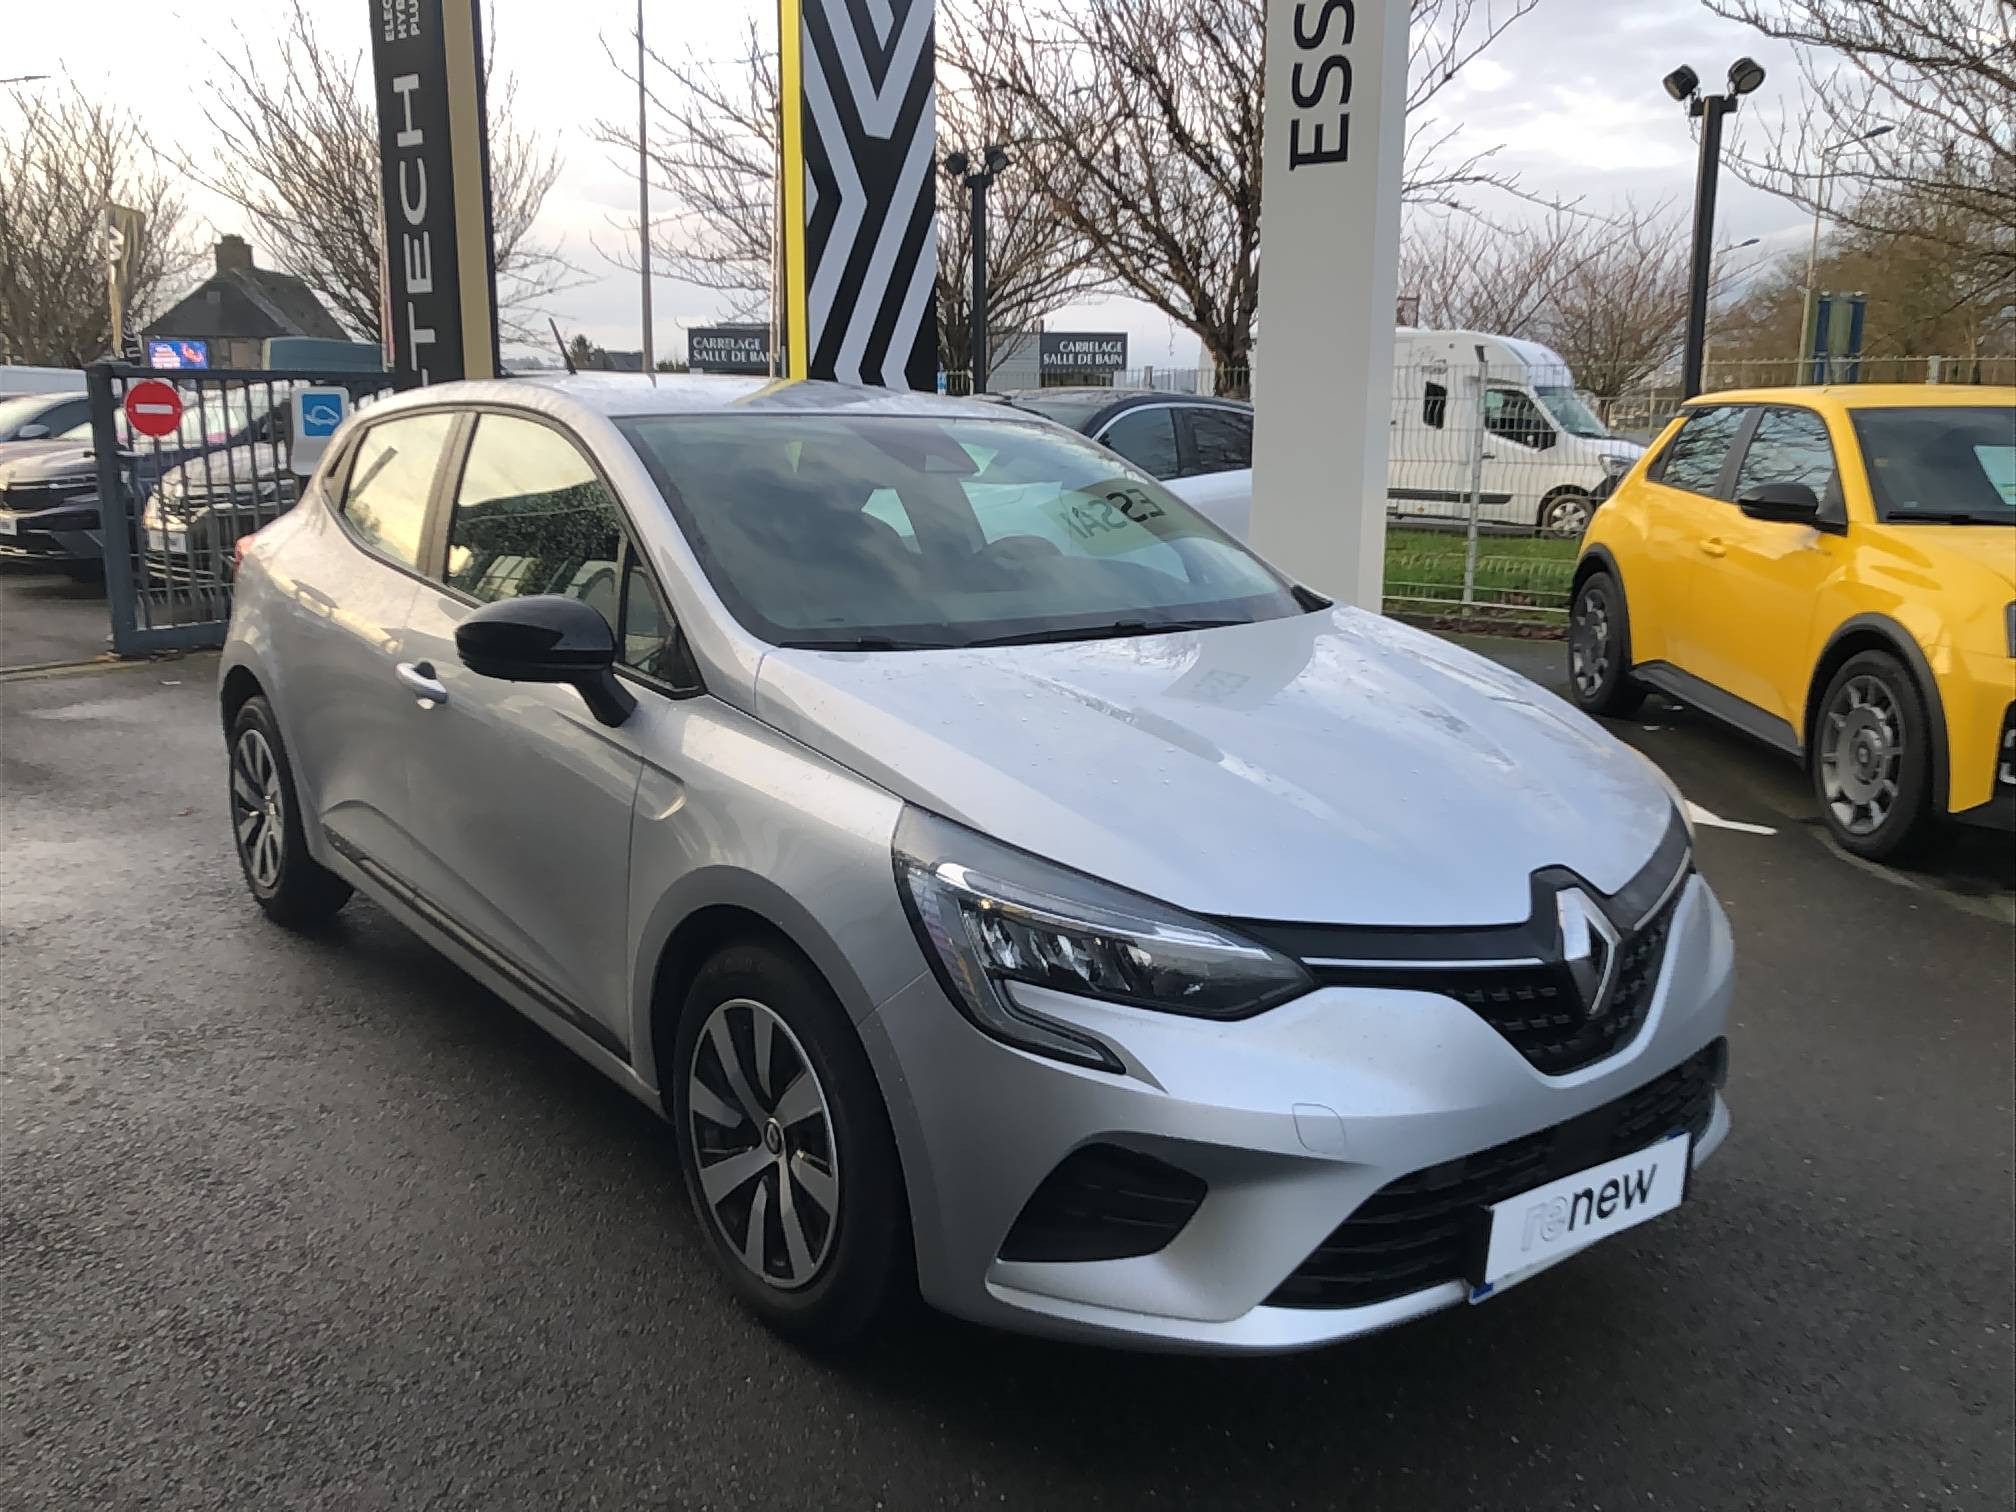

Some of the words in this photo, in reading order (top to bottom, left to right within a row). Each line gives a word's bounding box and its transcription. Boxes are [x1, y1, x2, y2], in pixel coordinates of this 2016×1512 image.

[693, 336, 761, 350] CARRELAGE
[1059, 340, 1123, 353] CARRELAGE
[693, 349, 728, 362] SALLE
[731, 350, 747, 363] DE
[1043, 353, 1075, 365] SALLE
[1077, 353, 1093, 365] DE
[1095, 353, 1123, 365] BAIN
